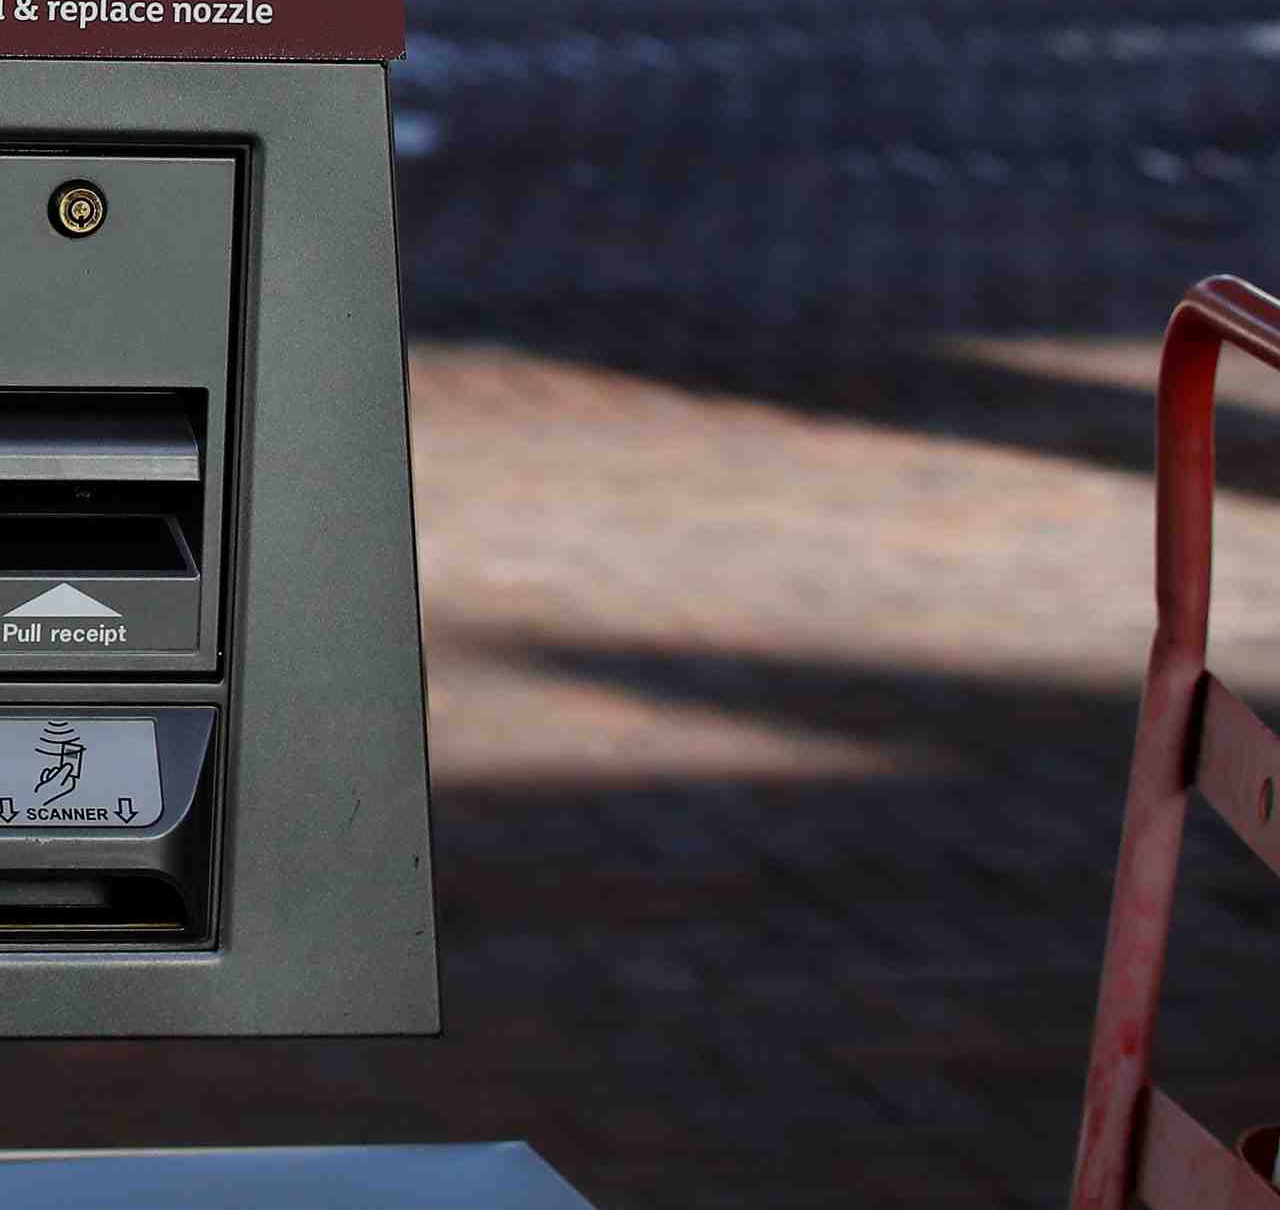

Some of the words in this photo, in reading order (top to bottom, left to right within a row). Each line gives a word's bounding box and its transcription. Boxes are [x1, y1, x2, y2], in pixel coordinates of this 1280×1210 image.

[3, 623, 41, 642] Pull
[50, 624, 127, 646] receipt
[26, 808, 108, 821] SCANNER
